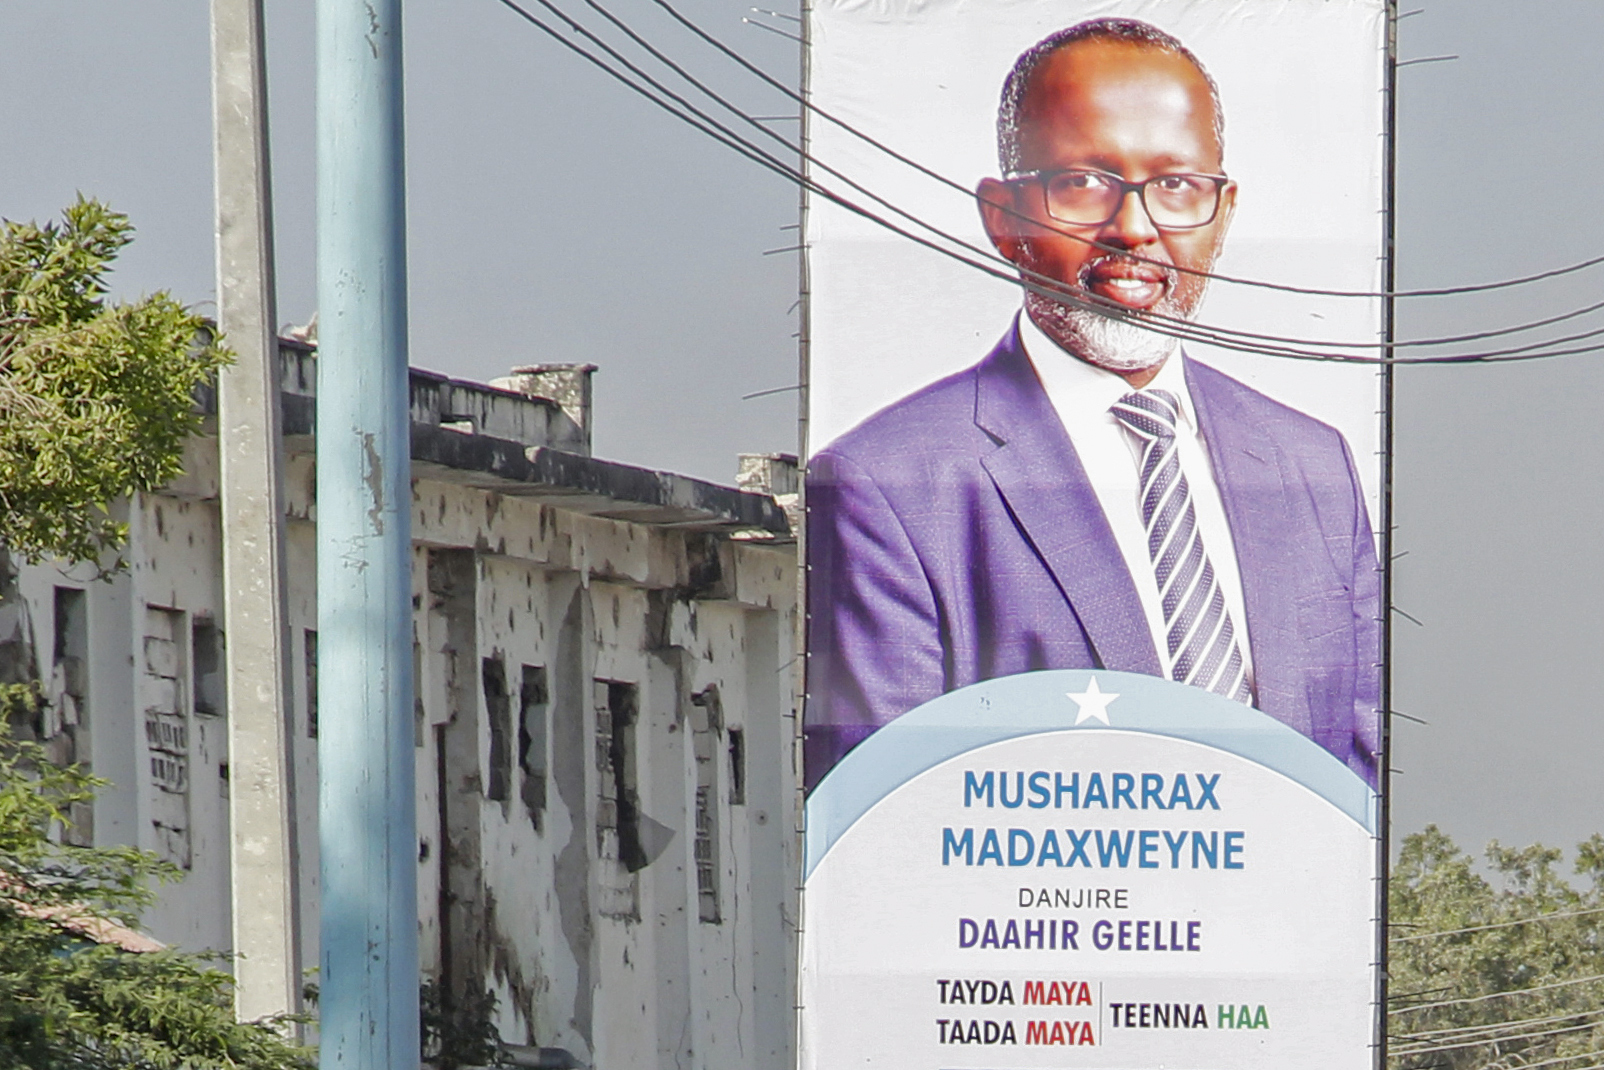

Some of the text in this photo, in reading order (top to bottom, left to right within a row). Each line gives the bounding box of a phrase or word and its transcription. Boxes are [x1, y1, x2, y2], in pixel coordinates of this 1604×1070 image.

[964, 770, 1221, 810] MUSHARRAX
[942, 827, 1245, 870] MADAXWEYNE
[1018, 887, 1129, 909] DANJIRE
[958, 918, 1201, 952] DAAHIR GEELLE
[936, 979, 1094, 1006] TAYDA MAYA
[1109, 1003, 1270, 1030] TEENNA HAA
[936, 1019, 1095, 1046] TAADA MAYA
